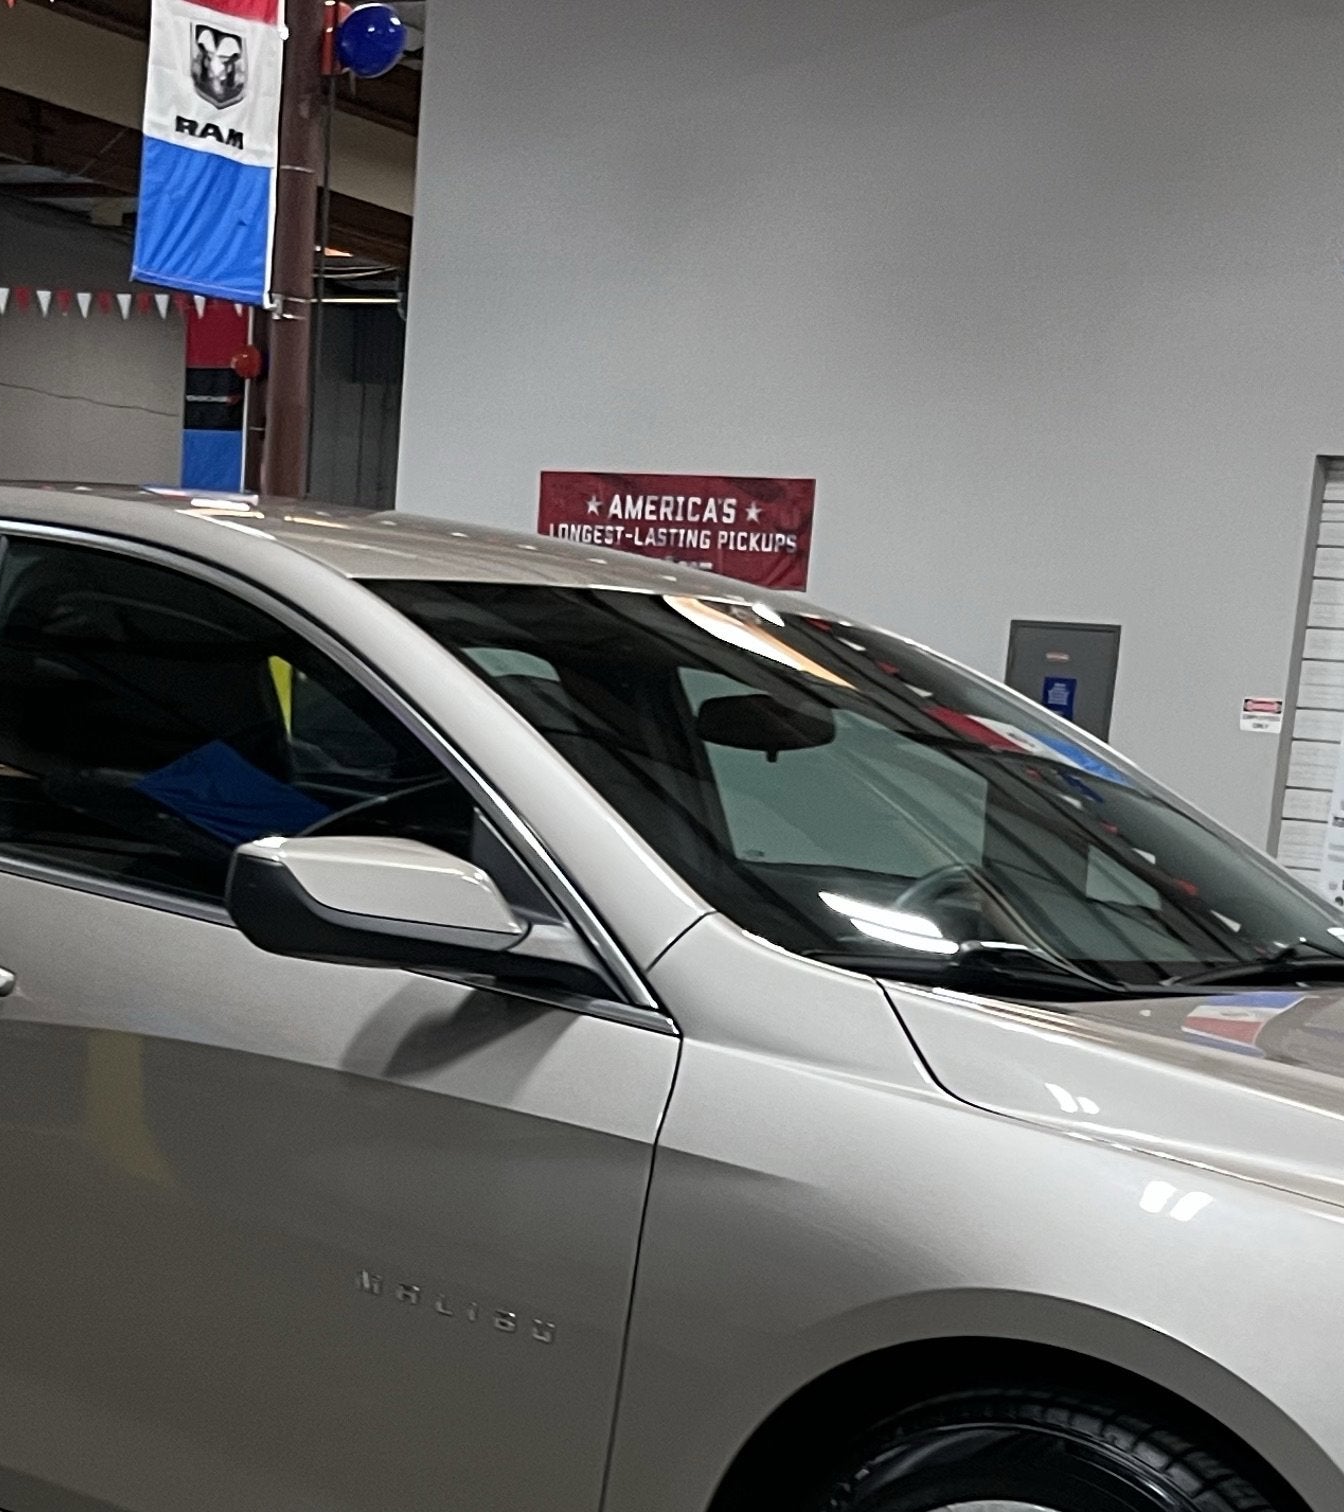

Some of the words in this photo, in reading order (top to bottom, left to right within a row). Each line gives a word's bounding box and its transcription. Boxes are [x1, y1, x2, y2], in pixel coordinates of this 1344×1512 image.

[174, 114, 244, 151] RAM
[607, 493, 738, 525] AMERICA'S
[549, 522, 712, 550] LONGEST-LASTING
[716, 529, 798, 554] PICKUPS
